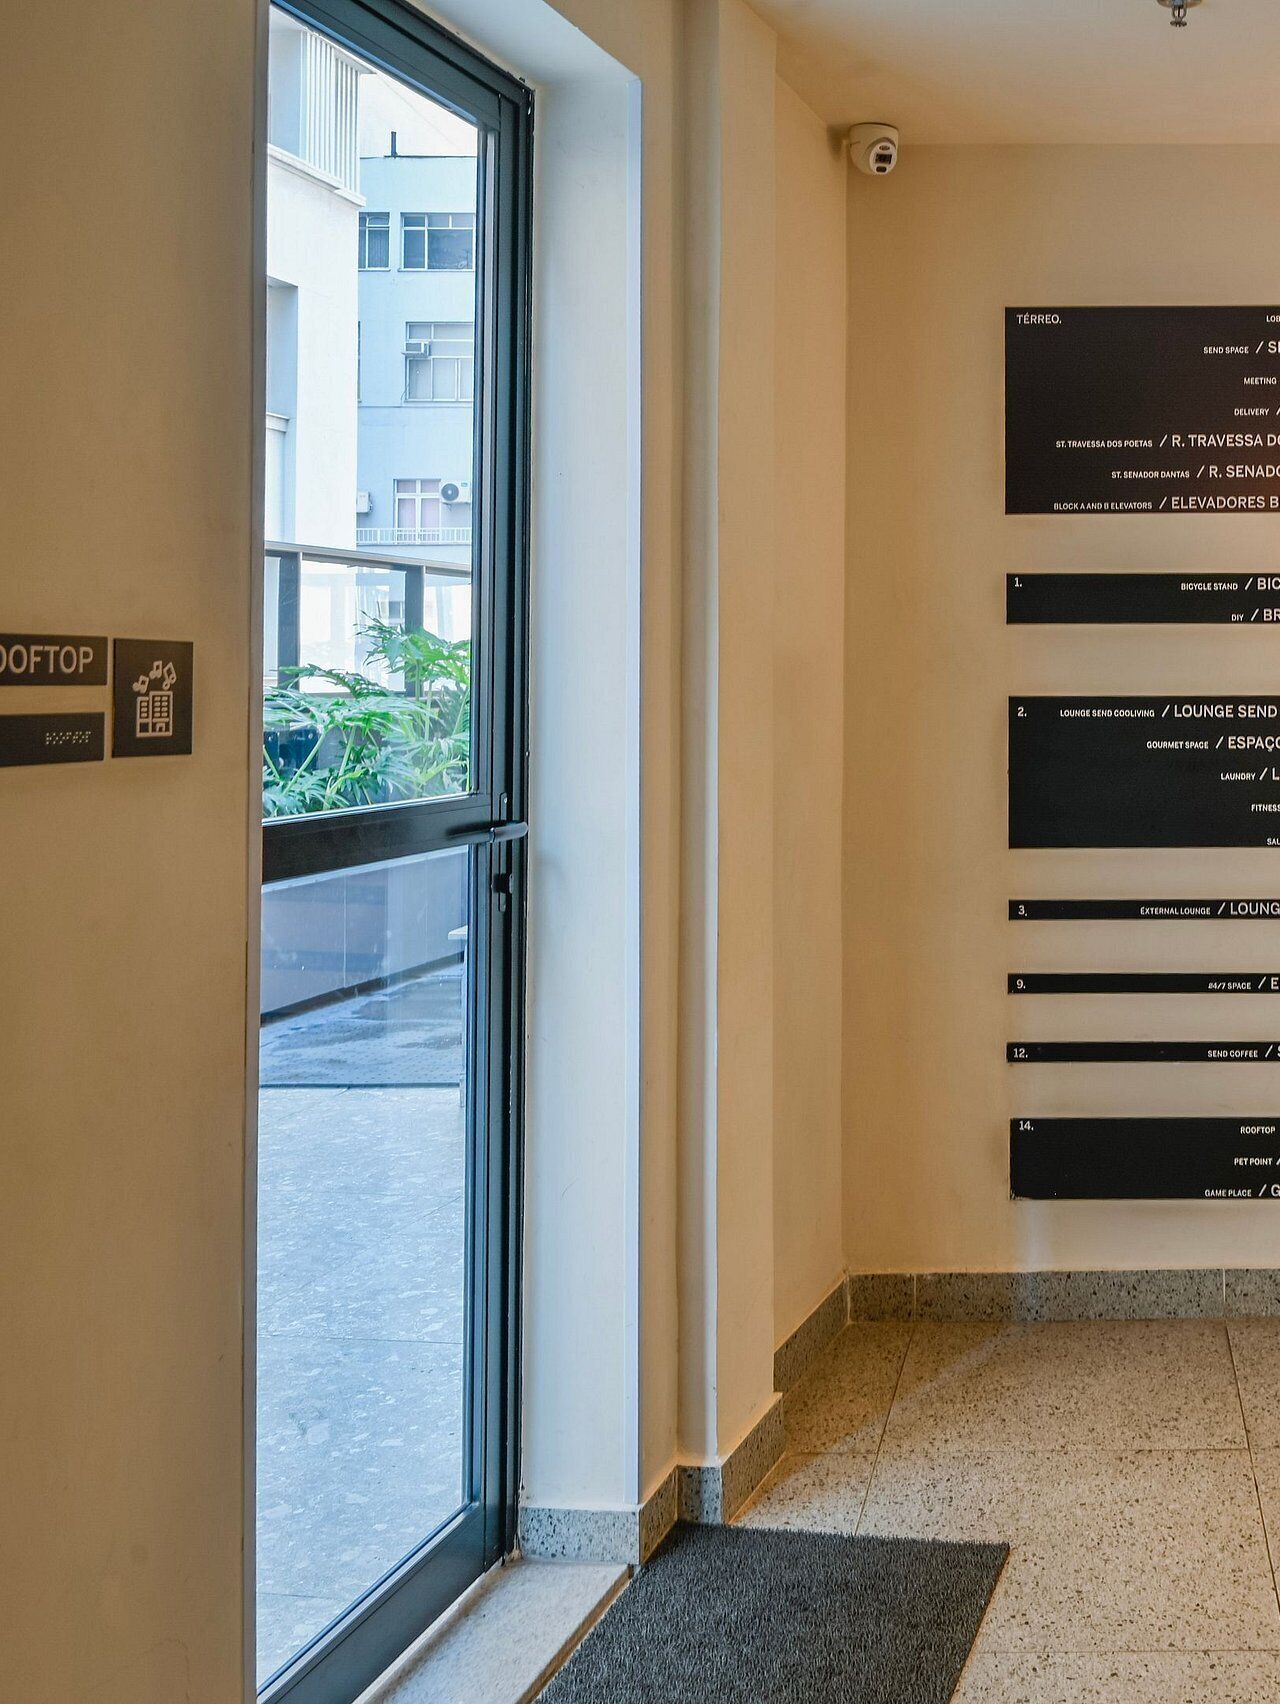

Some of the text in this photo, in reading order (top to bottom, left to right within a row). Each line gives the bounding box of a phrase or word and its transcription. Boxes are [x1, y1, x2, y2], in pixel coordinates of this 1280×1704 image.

[1016, 311, 1062, 325] TÉRREO.
[1203, 346, 1223, 354] SEND
[1225, 346, 1248, 354] SPACE
[1243, 376, 1276, 385] MEETING
[1233, 407, 1269, 416] DELIVERY
[1056, 440, 1066, 448] ST.
[1067, 440, 1105, 448] TRAVESSA
[1106, 439, 1122, 448] DOS
[1123, 439, 1152, 448] POETAS
[1171, 434, 1184, 448] R.
[1187, 433, 1263, 448] TRAVESSA
[1111, 471, 1121, 479] ST.
[1123, 470, 1158, 479] SENADOR
[1160, 470, 1189, 479] DANTAS
[1209, 465, 1221, 479] R.
[1053, 502, 1078, 510] BLOCK
[1079, 502, 1085, 510] A
[1086, 502, 1102, 510] AND
[1103, 502, 1109, 510] B
[1110, 501, 1152, 510] ELEVATORS
[1171, 495, 1265, 510] ELEVADORES
[1014, 576, 1023, 588] 1.
[1180, 582, 1211, 591] BICYCLE
[1213, 582, 1238, 591] STAND
[1231, 613, 1243, 622] DIY
[1017, 706, 1027, 718] 2.
[1059, 709, 1090, 718] LOUNGE
[1091, 708, 1112, 718] SEND
[1113, 709, 1154, 718] COOLIVING
[1173, 704, 1233, 718] LOUNGE
[1237, 704, 1277, 719] SEND
[1146, 740, 1183, 750] GOURMET
[1184, 740, 1208, 750] SPACE
[1220, 772, 1255, 781] LAUNDRY
[1018, 904, 1028, 917] 3.
[1140, 906, 1177, 916] EXTERNAL
[1180, 906, 1210, 915] LOUNGE
[1016, 978, 1026, 989] 9.
[1227, 982, 1251, 990] SPACE
[1013, 1047, 1028, 1059] 12.
[1207, 1049, 1228, 1058] SEND
[1229, 1049, 1258, 1058] COFFEE
[1019, 1120, 1034, 1131] 14.
[1240, 1125, 1275, 1135] ROOFTOP
[1233, 1157, 1248, 1166] PET
[1249, 1157, 1272, 1166] POINT
[1204, 1188, 1226, 1197] GAME
[1227, 1188, 1251, 1197] PLACE
